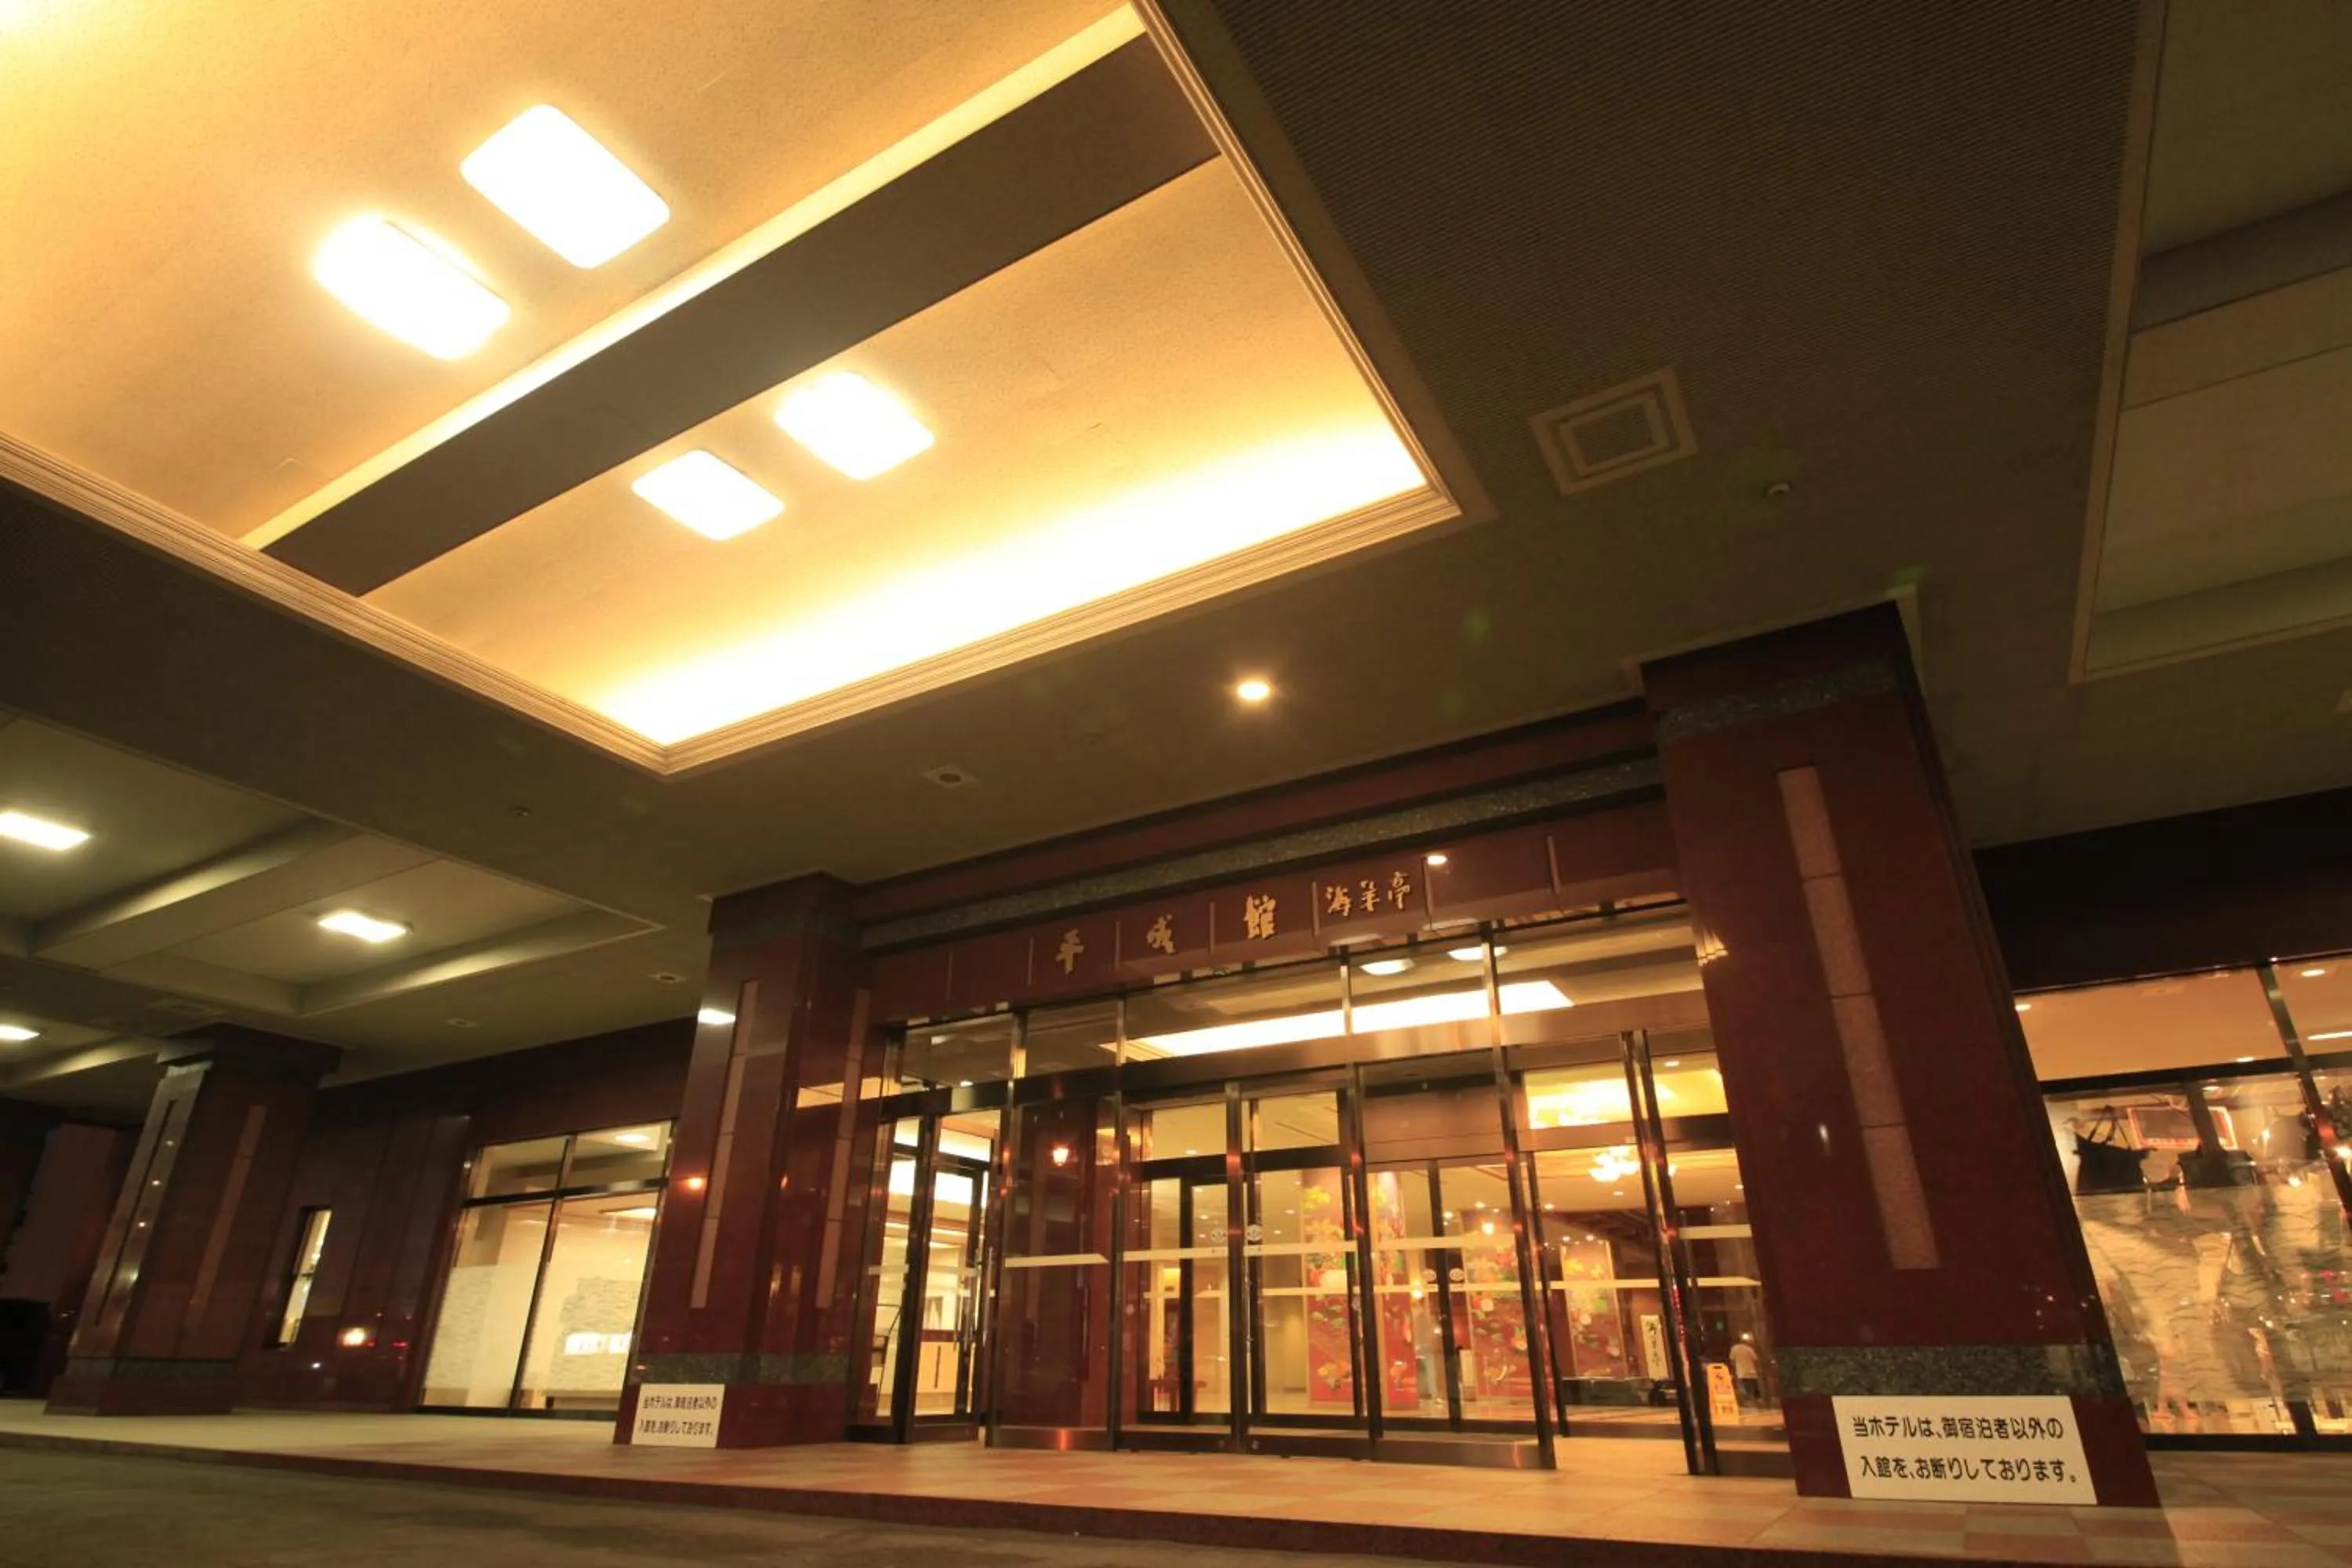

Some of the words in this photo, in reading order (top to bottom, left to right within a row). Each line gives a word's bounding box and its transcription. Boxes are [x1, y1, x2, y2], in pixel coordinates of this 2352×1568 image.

[1853, 1416, 2063, 1440] 当ホテルは、御宿泊者以外の
[1861, 1456, 2078, 1483] 入館を、お断りしております。
